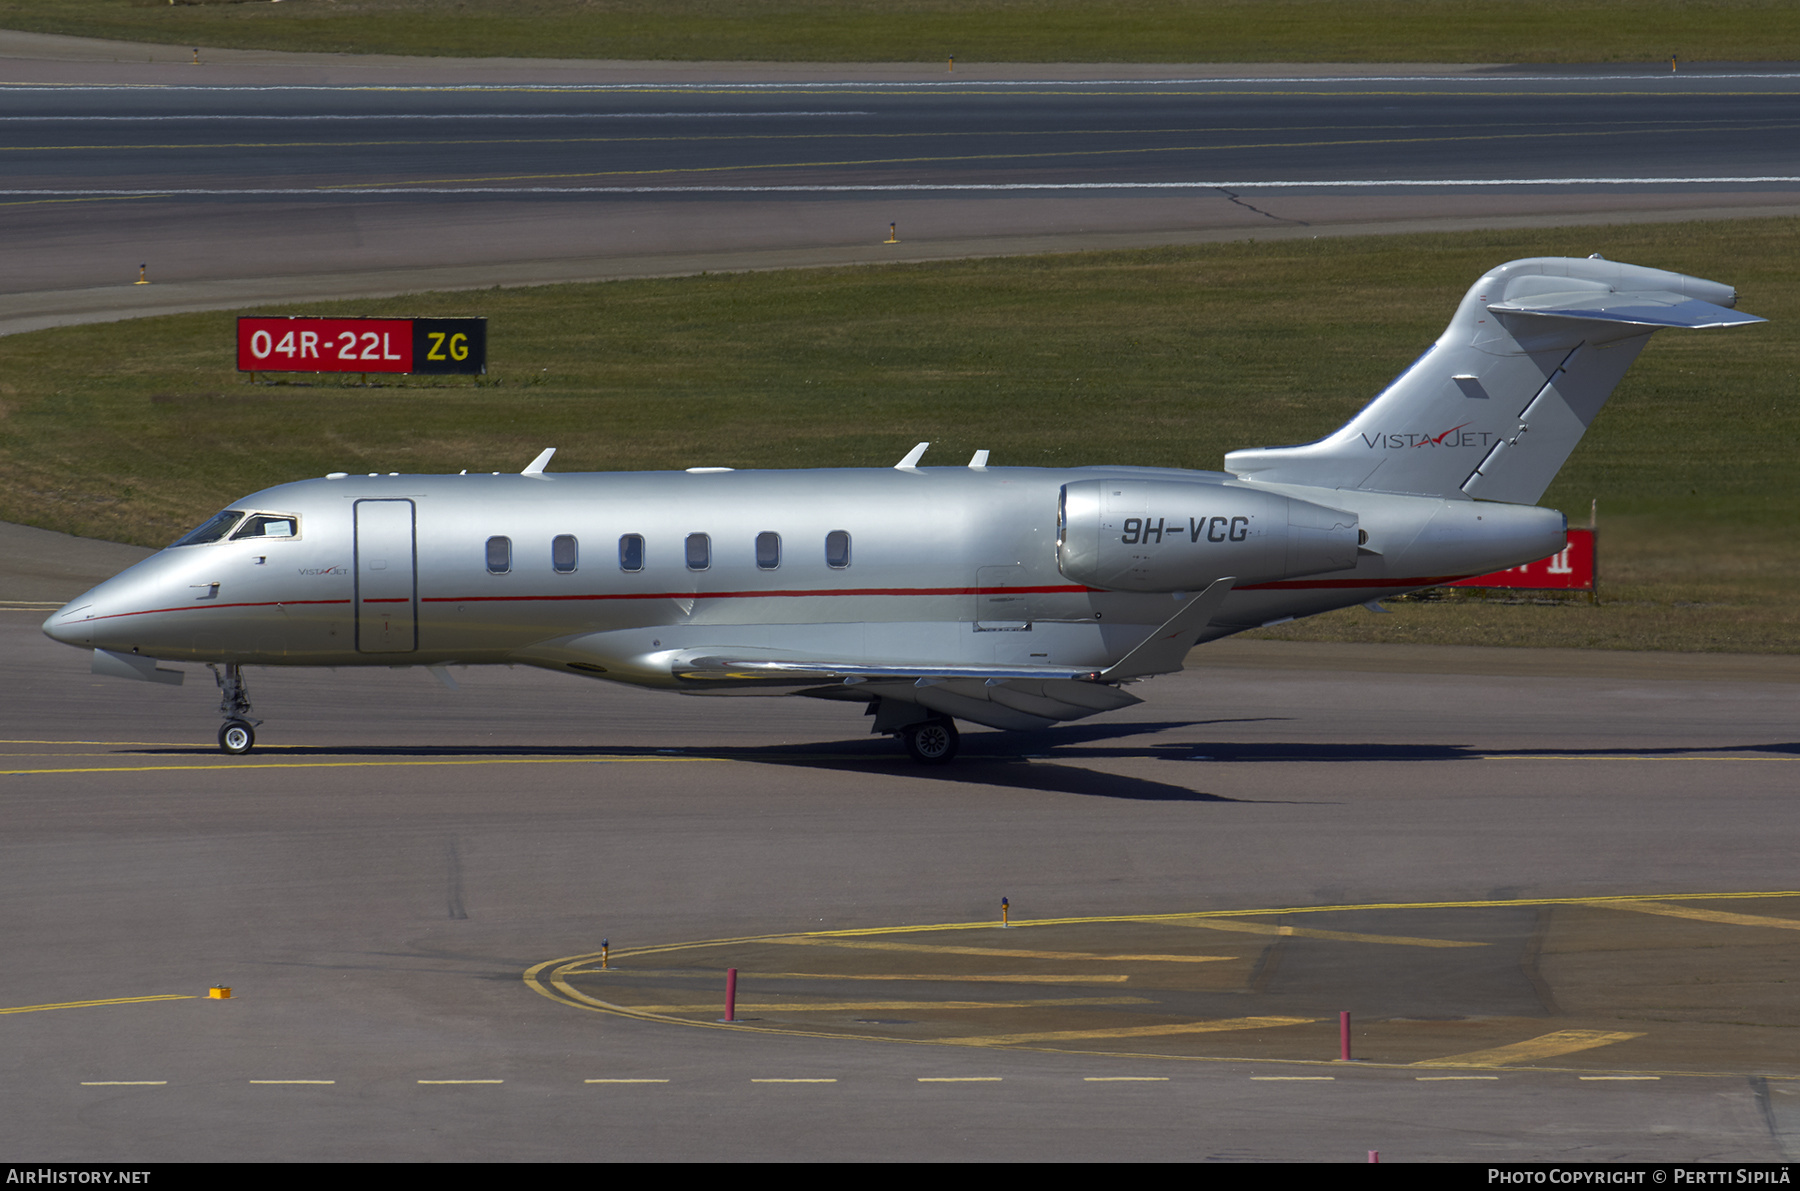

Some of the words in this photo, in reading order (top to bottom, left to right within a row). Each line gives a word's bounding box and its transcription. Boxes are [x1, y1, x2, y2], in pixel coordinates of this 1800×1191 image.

[251, 329, 401, 360] 04R-22L
[426, 332, 469, 361] ZG
[1122, 516, 1249, 544] 9H-VCG
